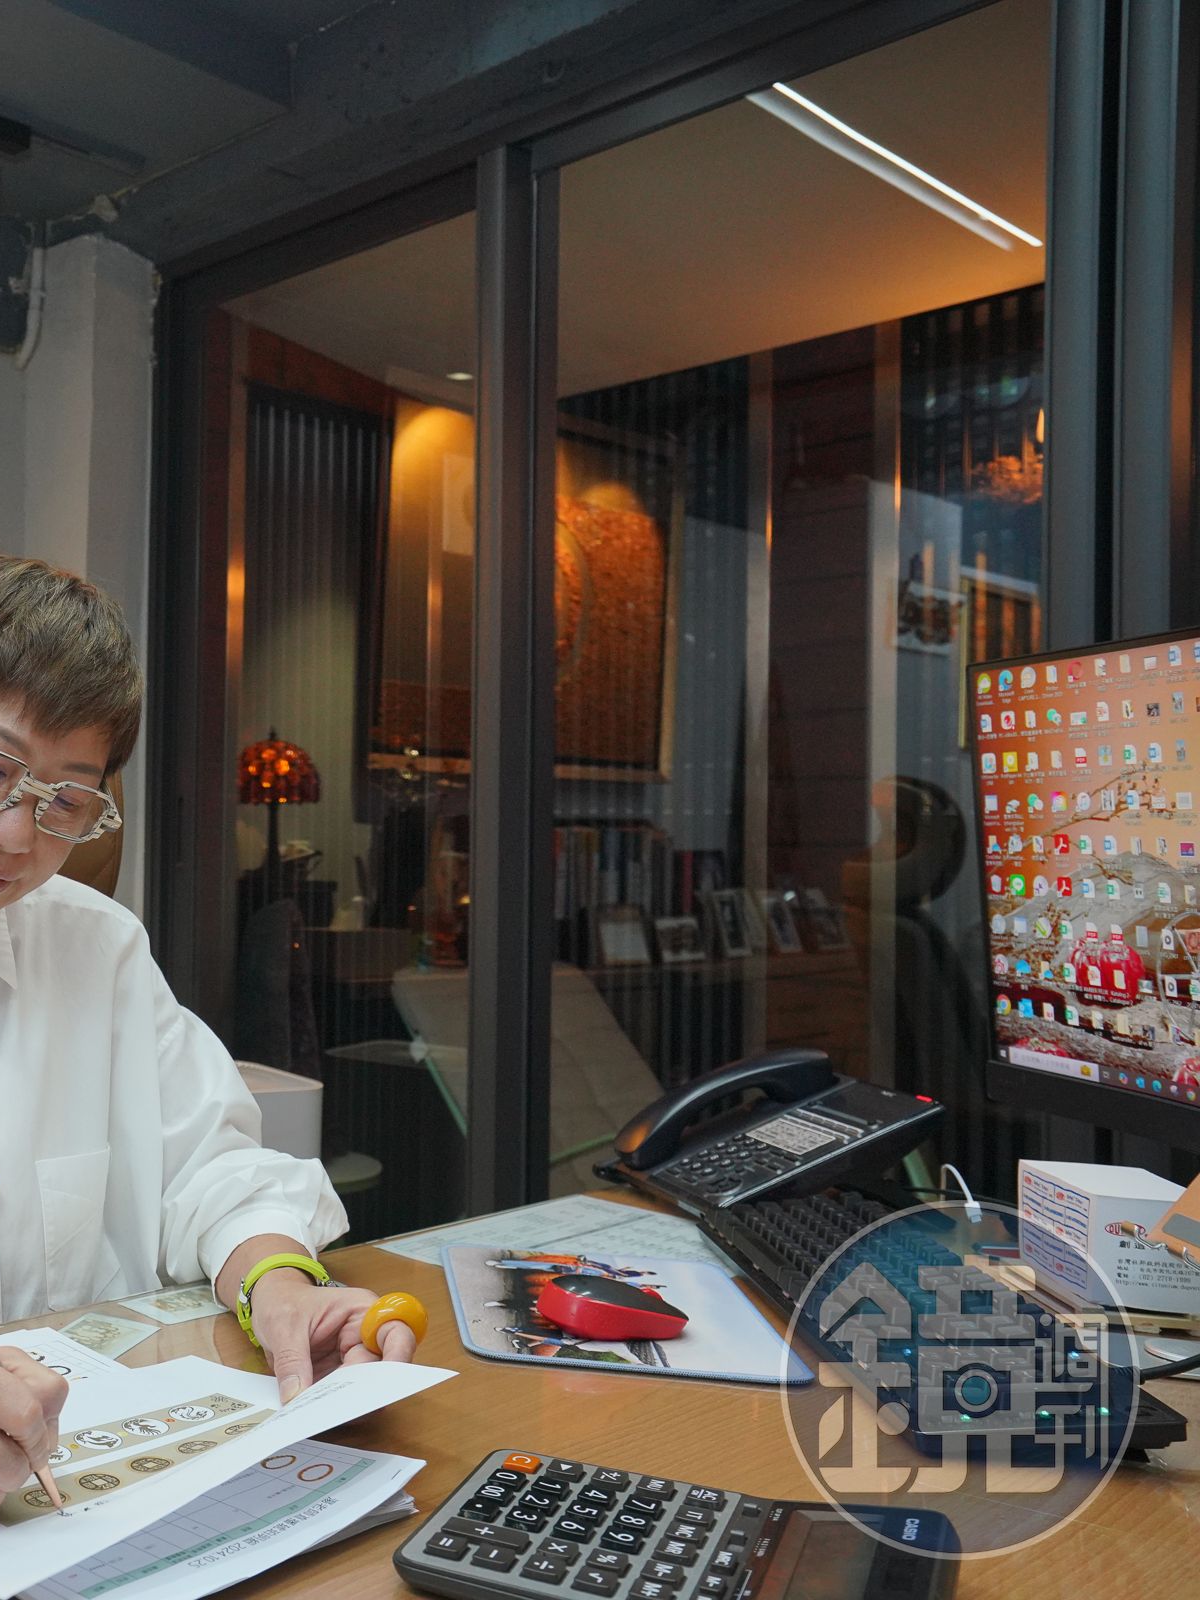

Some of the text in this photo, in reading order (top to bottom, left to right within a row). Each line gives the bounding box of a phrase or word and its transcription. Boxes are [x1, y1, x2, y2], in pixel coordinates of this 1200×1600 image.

[512, 1455, 531, 1464] C
[539, 1481, 561, 1490] 1
[525, 1494, 549, 1505] 2
[584, 1489, 608, 1499] 4
[573, 1504, 598, 1516] 5
[631, 1499, 656, 1510] 7
[513, 1509, 538, 1521] 3
[620, 1514, 646, 1525] 8
[560, 1520, 585, 1531] 6
[674, 1524, 696, 1538] MC
[902, 1518, 920, 1541] CASIO
[608, 1531, 635, 1543] 9
[664, 1540, 686, 1555] MR
